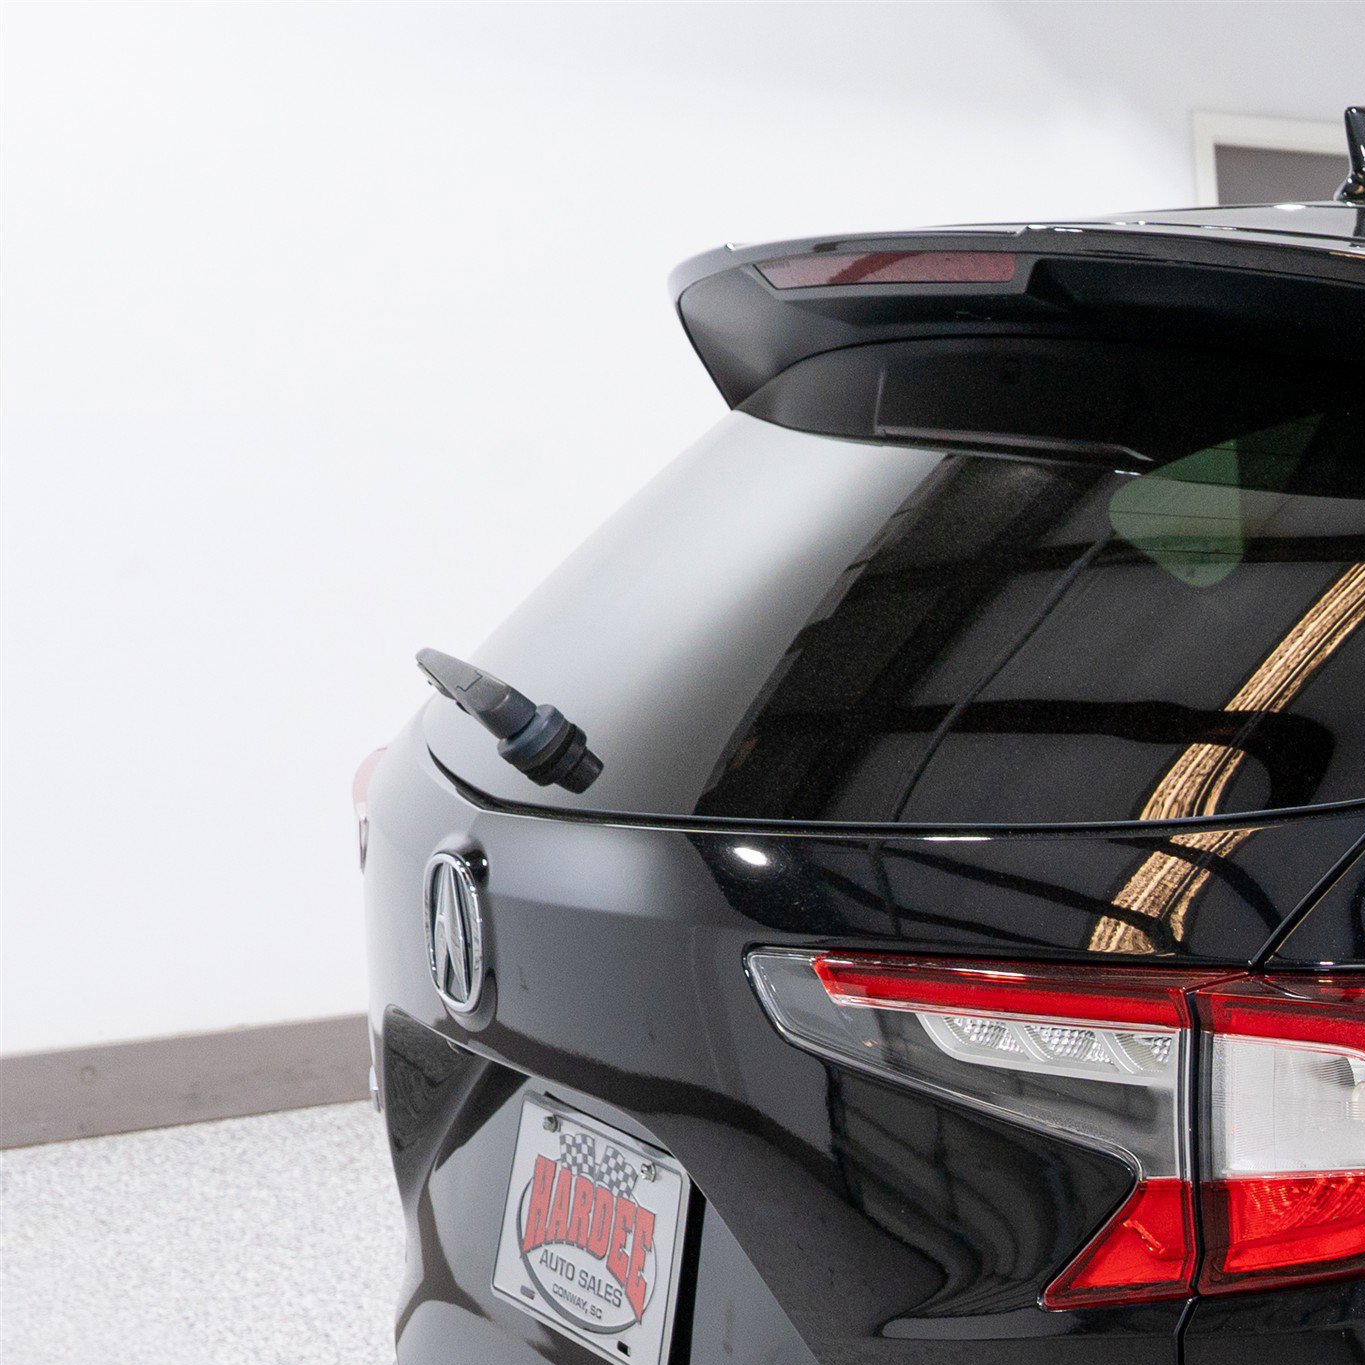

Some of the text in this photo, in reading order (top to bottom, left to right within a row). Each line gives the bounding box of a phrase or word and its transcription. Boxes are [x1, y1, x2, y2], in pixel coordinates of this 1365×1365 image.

[521, 1153, 657, 1324] HARDEE
[539, 1249, 623, 1308] AUTO SALES
[552, 1283, 603, 1319] CONWAY, SC
